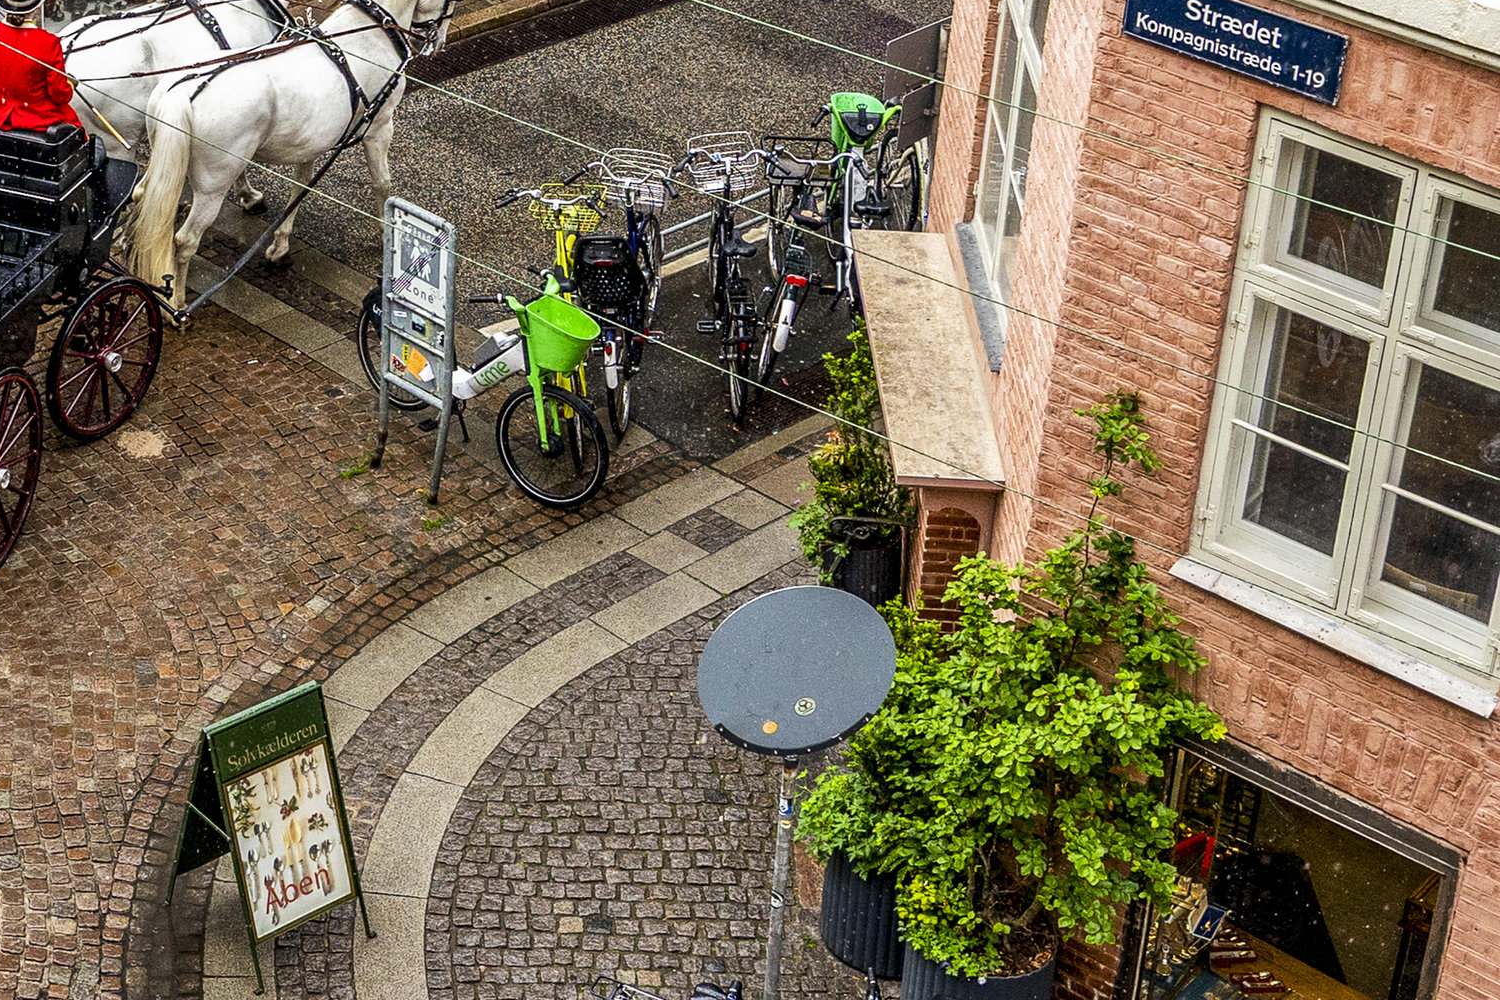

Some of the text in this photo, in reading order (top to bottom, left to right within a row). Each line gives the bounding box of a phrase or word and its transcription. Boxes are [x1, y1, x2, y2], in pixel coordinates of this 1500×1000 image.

[1135, 11, 1326, 89] Kompagnistræde 1-19
[473, 360, 511, 388] Lime
[264, 868, 332, 915] Åben
